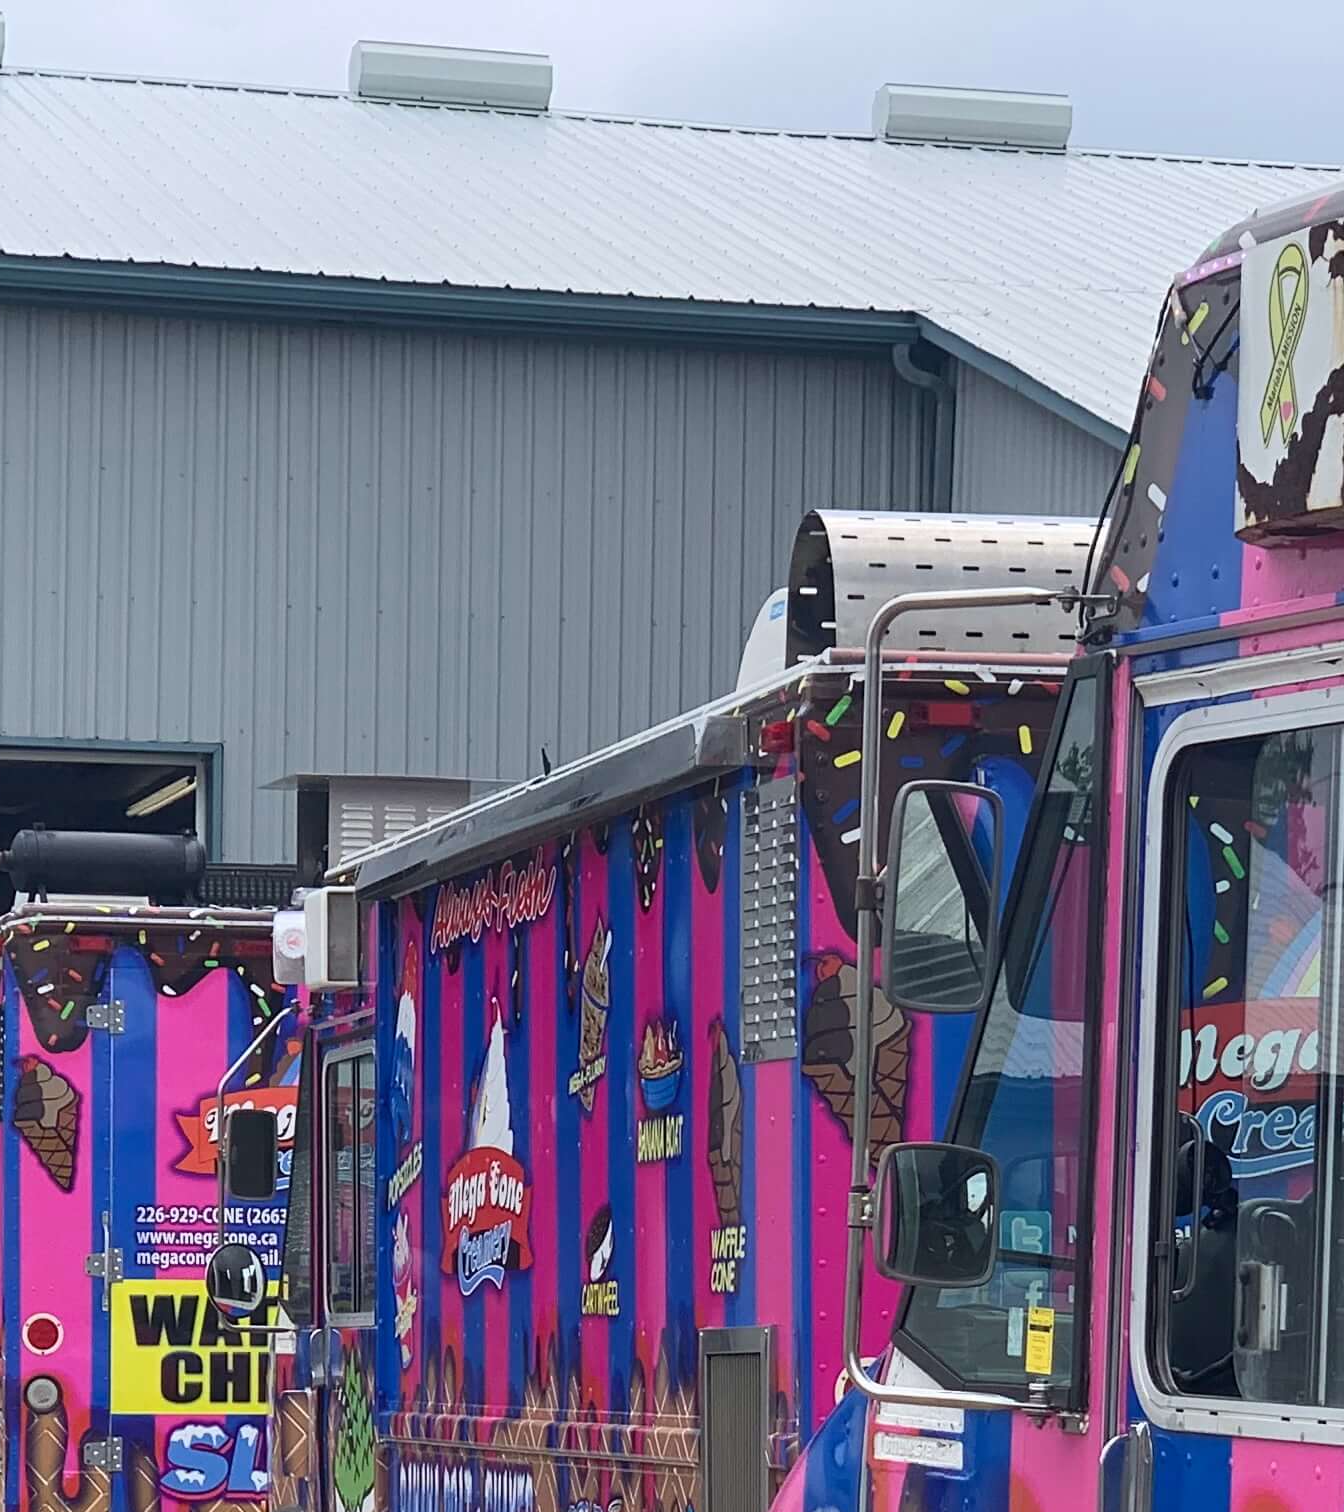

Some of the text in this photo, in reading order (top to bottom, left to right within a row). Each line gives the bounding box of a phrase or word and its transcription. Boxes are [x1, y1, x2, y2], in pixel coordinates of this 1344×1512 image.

[1267, 302, 1302, 410] Mariah's MISSION
[246, 1207, 287, 1226] (2663
[449, 1160, 524, 1231] Mega Cone
[459, 1219, 513, 1290] Creamery
[711, 1225, 747, 1260] WAFFLE
[711, 1260, 736, 1293] CONE
